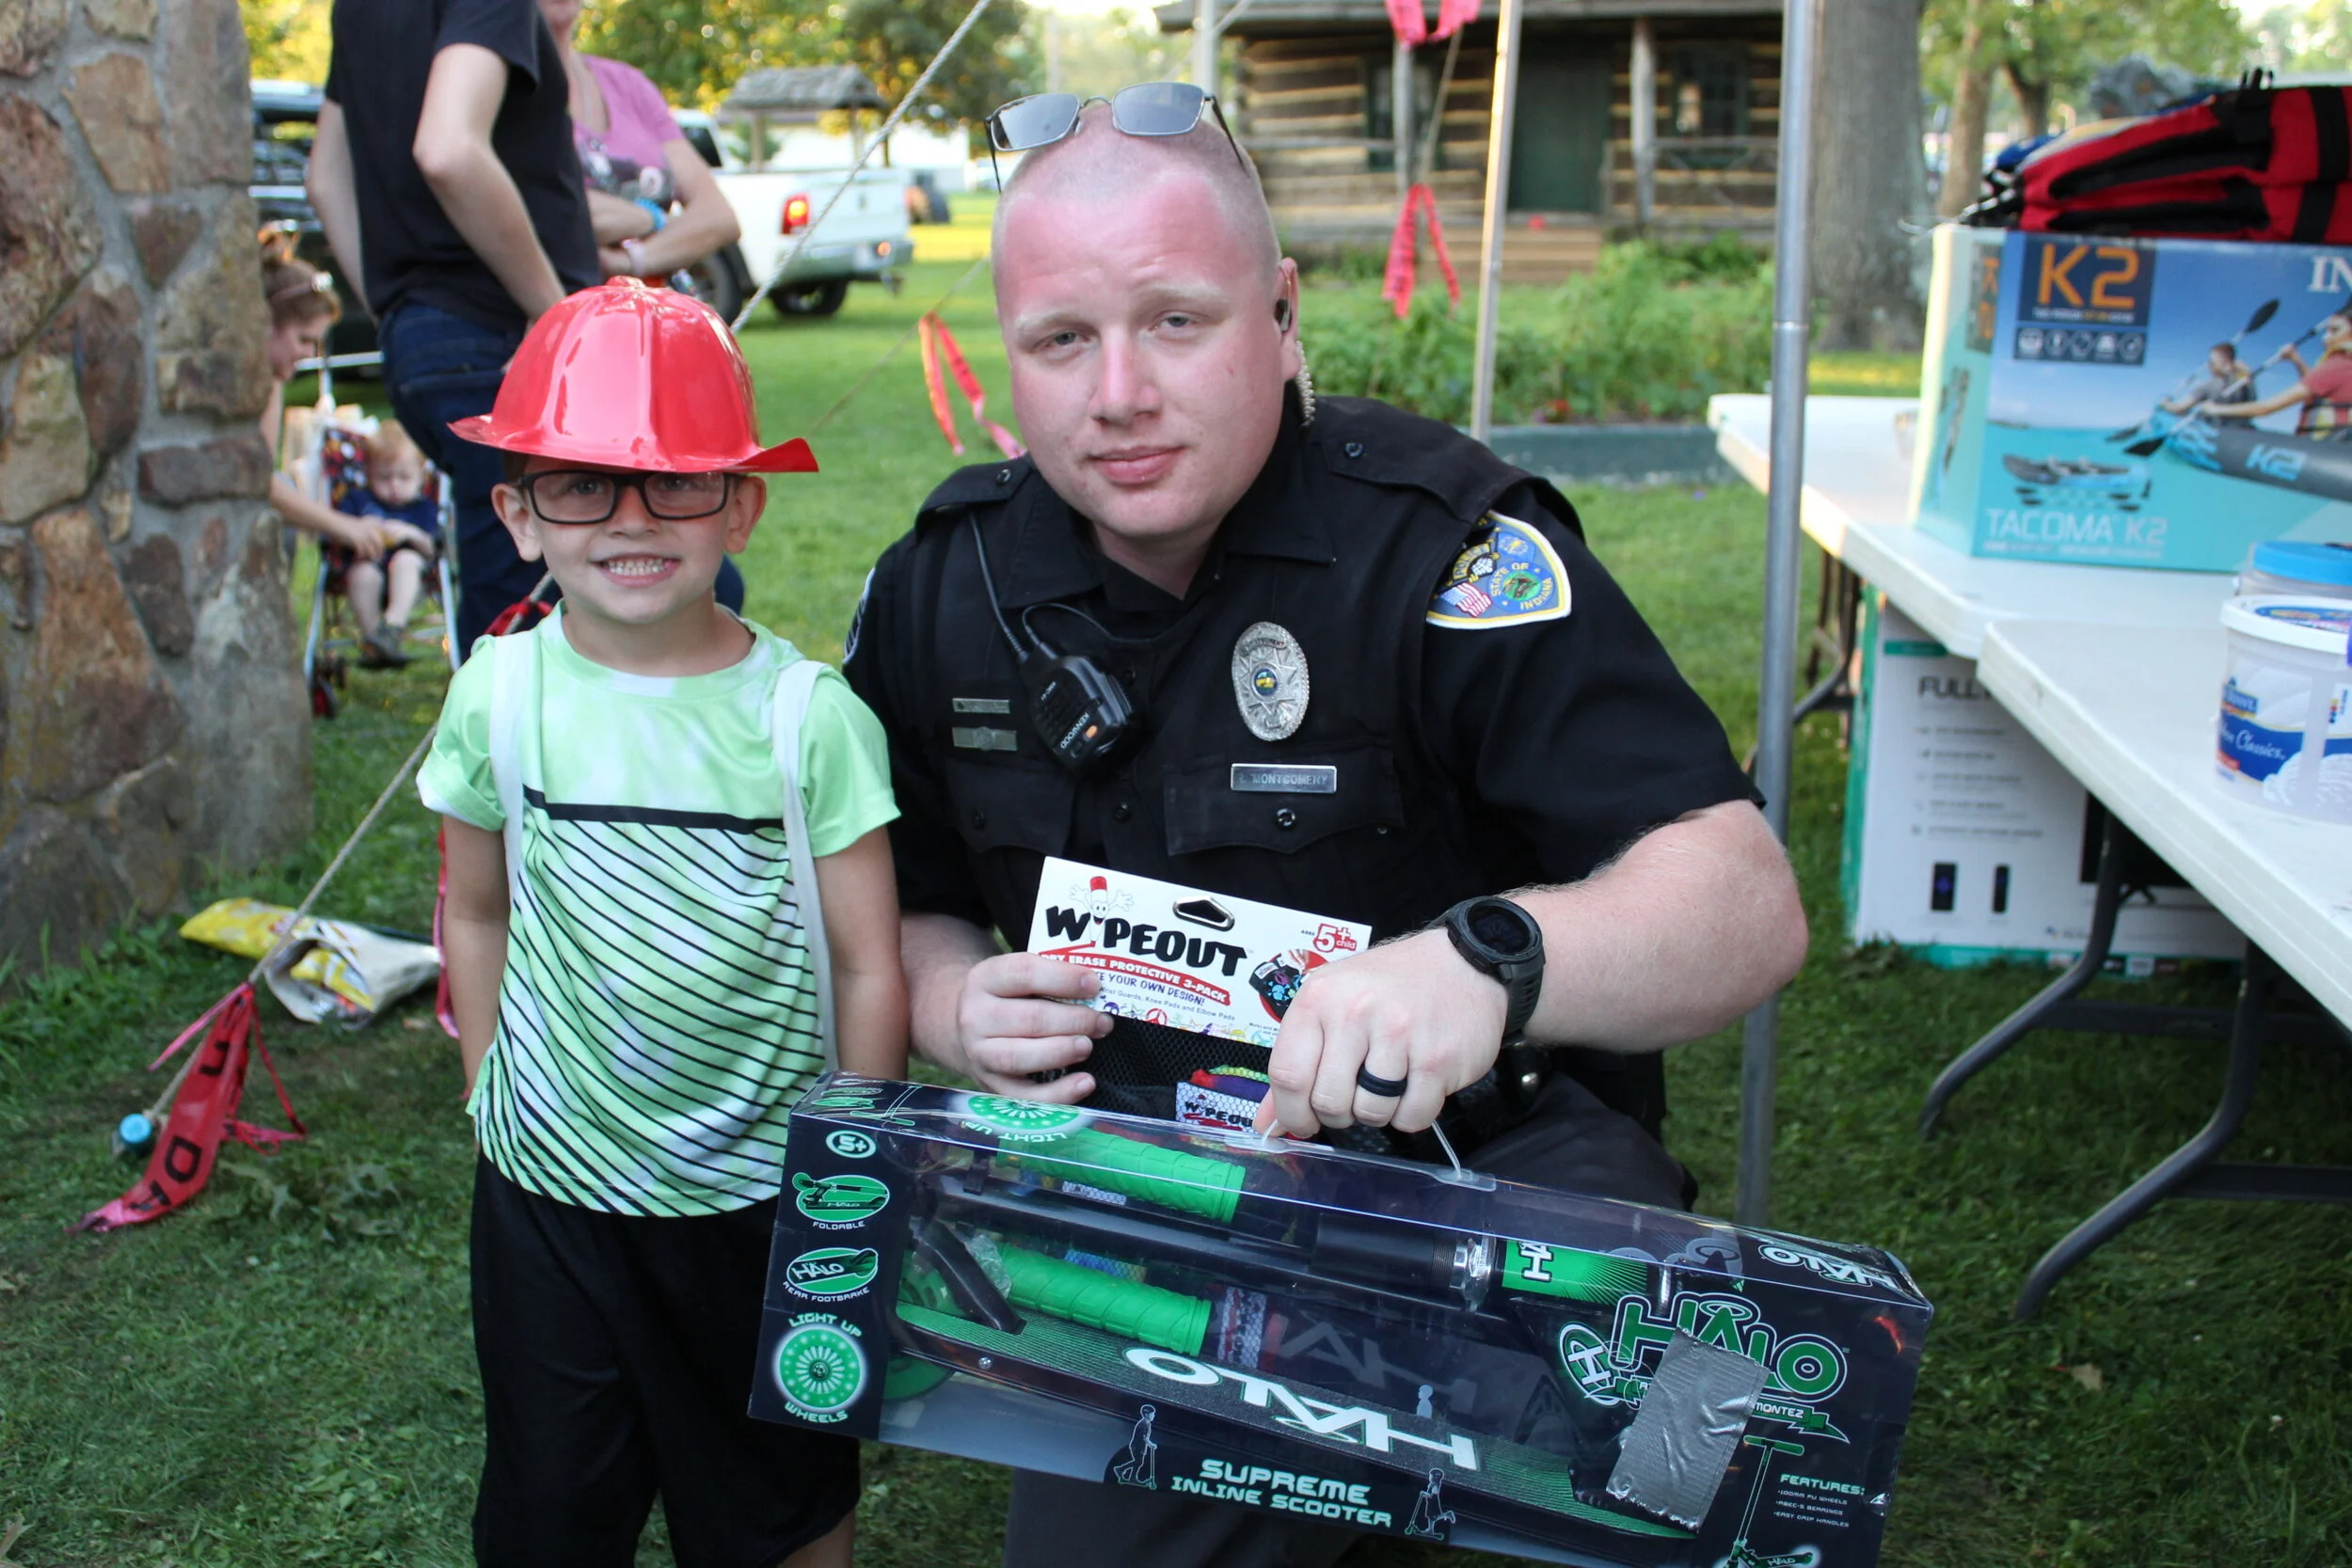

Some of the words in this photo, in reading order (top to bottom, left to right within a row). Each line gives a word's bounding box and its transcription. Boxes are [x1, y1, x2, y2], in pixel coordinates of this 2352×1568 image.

[2038, 243, 2138, 309] K2
[2246, 443, 2307, 482] K2
[1985, 507, 2114, 543] TACOMA
[2124, 515, 2168, 546] K2
[1490, 566, 1509, 597] STATE
[1511, 562, 1529, 570] OF
[1519, 577, 1553, 610] INDIANA
[1060, 712, 1089, 749] KENWOOD
[1250, 773, 1328, 785] MONTGOMERY
[1313, 924, 1351, 953] 5+
[1336, 940, 1356, 949] child
[1069, 955, 1106, 967] ERASE
[1109, 959, 1181, 985] PROTECTIVE
[1183, 979, 1227, 1002] 3-PACK
[1108, 973, 1136, 987] YOUR
[1140, 980, 1166, 994] OWN
[1168, 988, 1205, 1006] DESIGN!
[1164, 1000, 1180, 1009] Pads
[1196, 1007, 1216, 1017] Elbow
[1218, 1012, 1235, 1021] Pads
[837, 1134, 867, 1152] 5+
[997, 1132, 1068, 1143] LIGHT
[812, 1221, 866, 1230] FOLDABLE
[790, 1261, 845, 1280] HALO
[782, 1280, 808, 1300] REAR
[811, 1287, 870, 1303] FOOTBRAKE
[788, 1311, 838, 1328] LIGHT
[840, 1322, 863, 1338] UP
[783, 1400, 849, 1424] WHEELS
[1126, 1347, 1480, 1471] HALO
[1200, 1458, 1372, 1506] SUPREME
[1780, 1473, 1866, 1496] FEATURES:
[1170, 1475, 1262, 1506] INLINE
[1270, 1493, 1392, 1528] SCOOTER
[1806, 1505, 1843, 1515] BEARINGS
[1819, 1496, 1848, 1505] WHEELS
[1816, 1517, 1850, 1528] HANDLES
[1767, 1557, 1796, 1566] HALO
